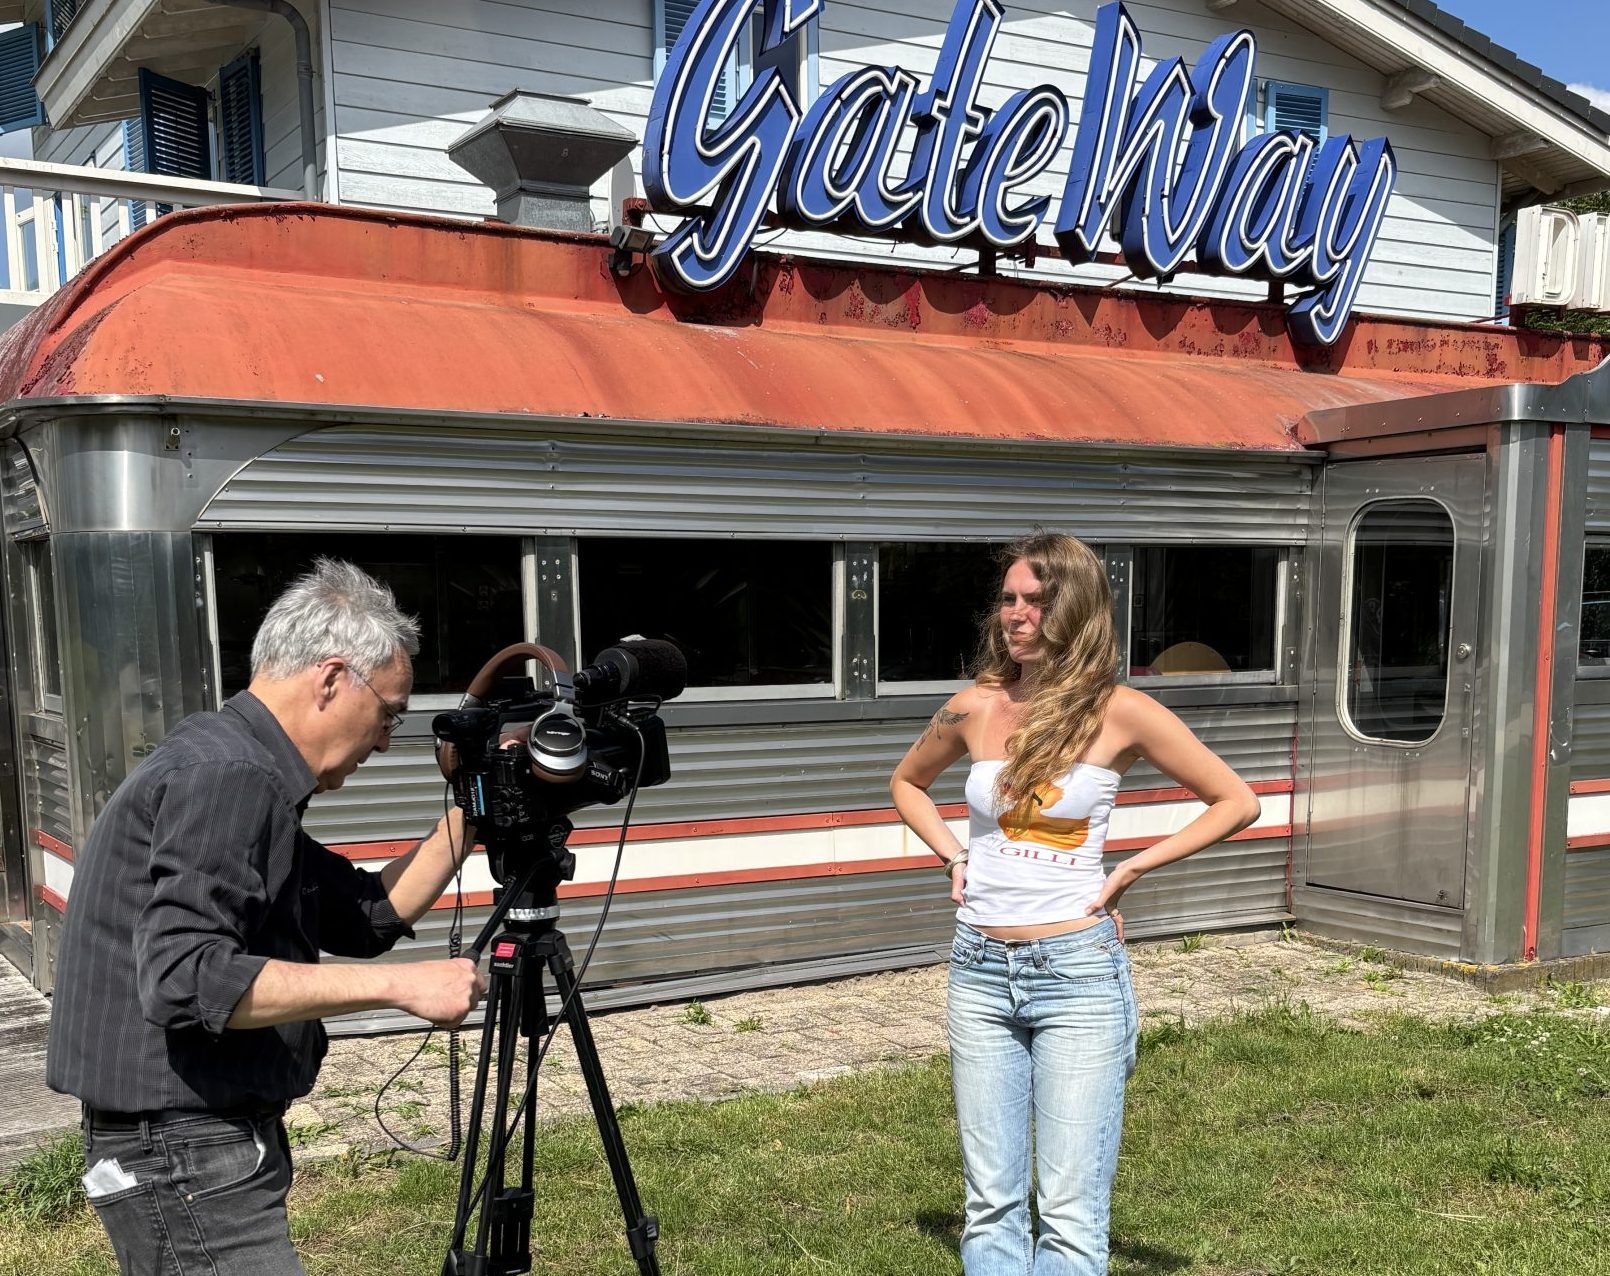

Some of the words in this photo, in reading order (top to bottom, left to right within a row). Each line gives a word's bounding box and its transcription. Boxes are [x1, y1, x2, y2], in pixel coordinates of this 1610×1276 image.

[642, 0, 1397, 347] GateWay
[1512, 205, 1610, 311] DI
[1000, 847, 1077, 866] GILLI
